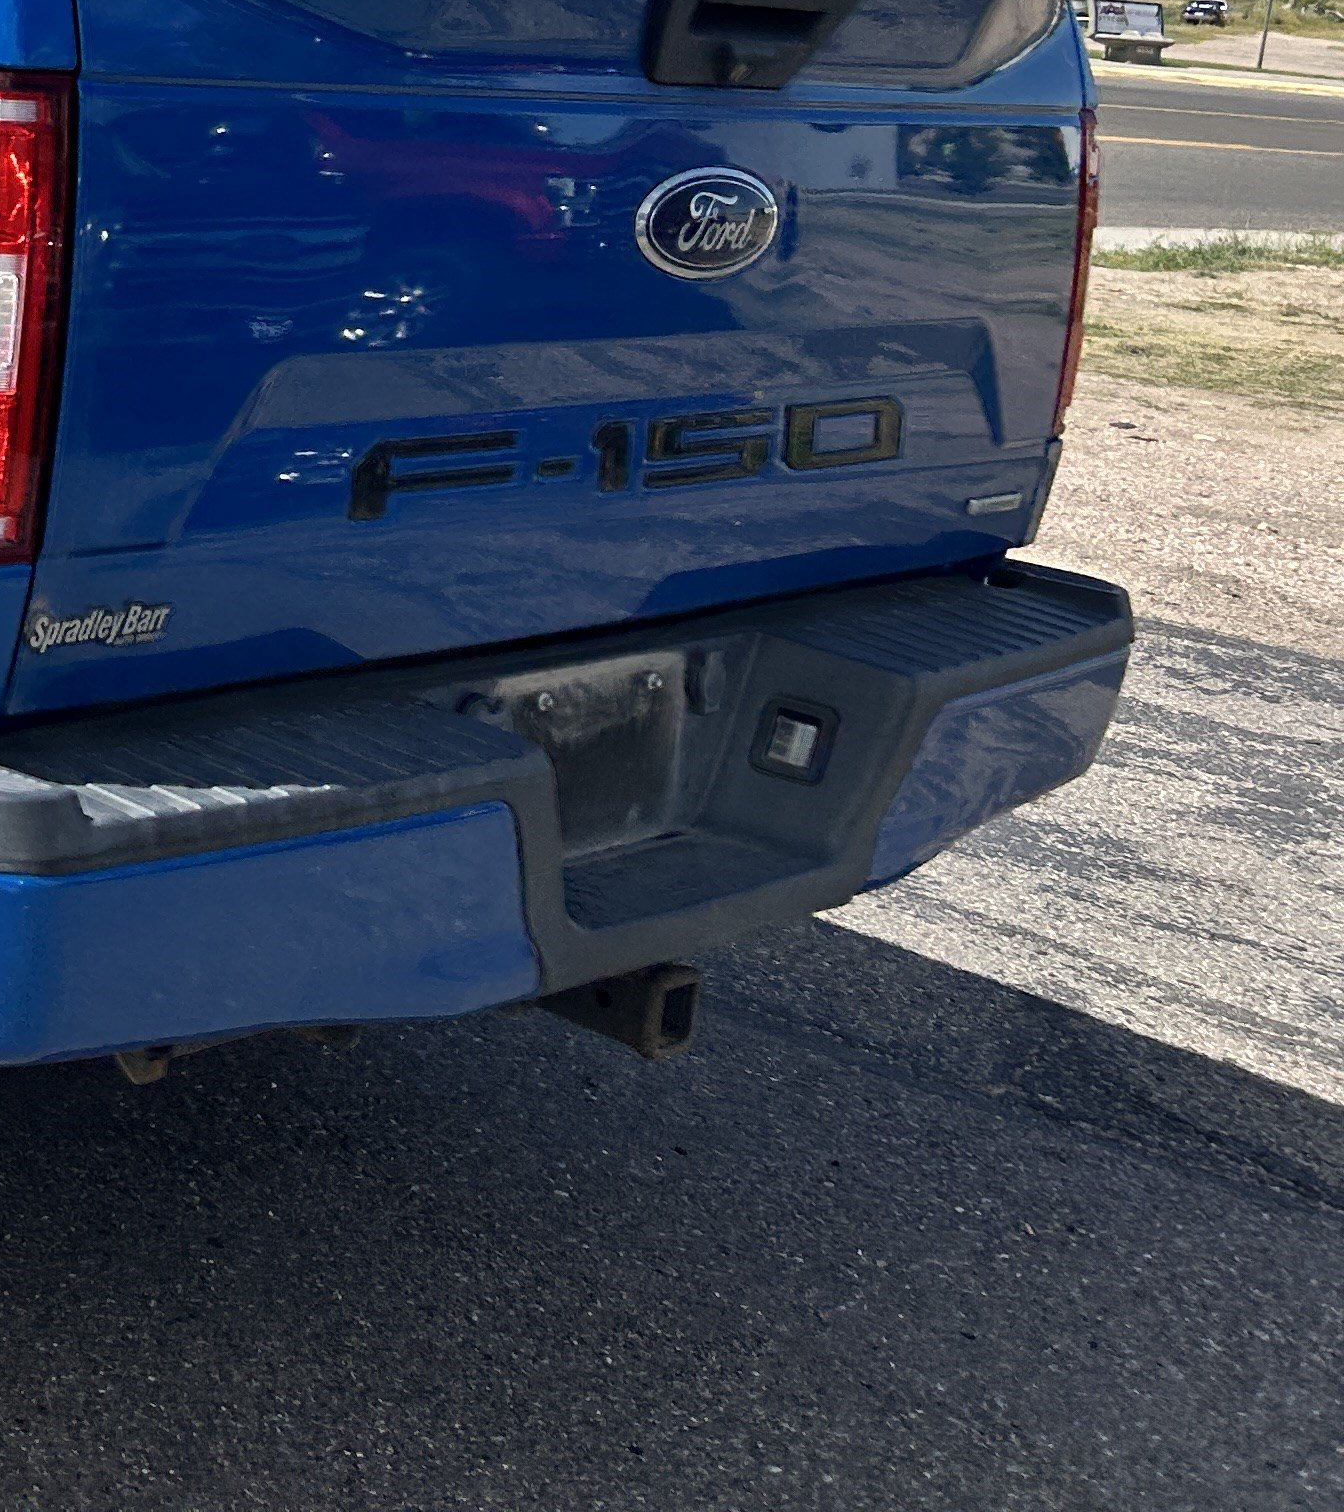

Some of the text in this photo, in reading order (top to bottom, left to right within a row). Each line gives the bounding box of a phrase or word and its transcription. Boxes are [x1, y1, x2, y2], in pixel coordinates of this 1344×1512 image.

[677, 191, 756, 252] Ford
[346, 394, 905, 524] F-150
[29, 605, 171, 654] Spradley Barr
